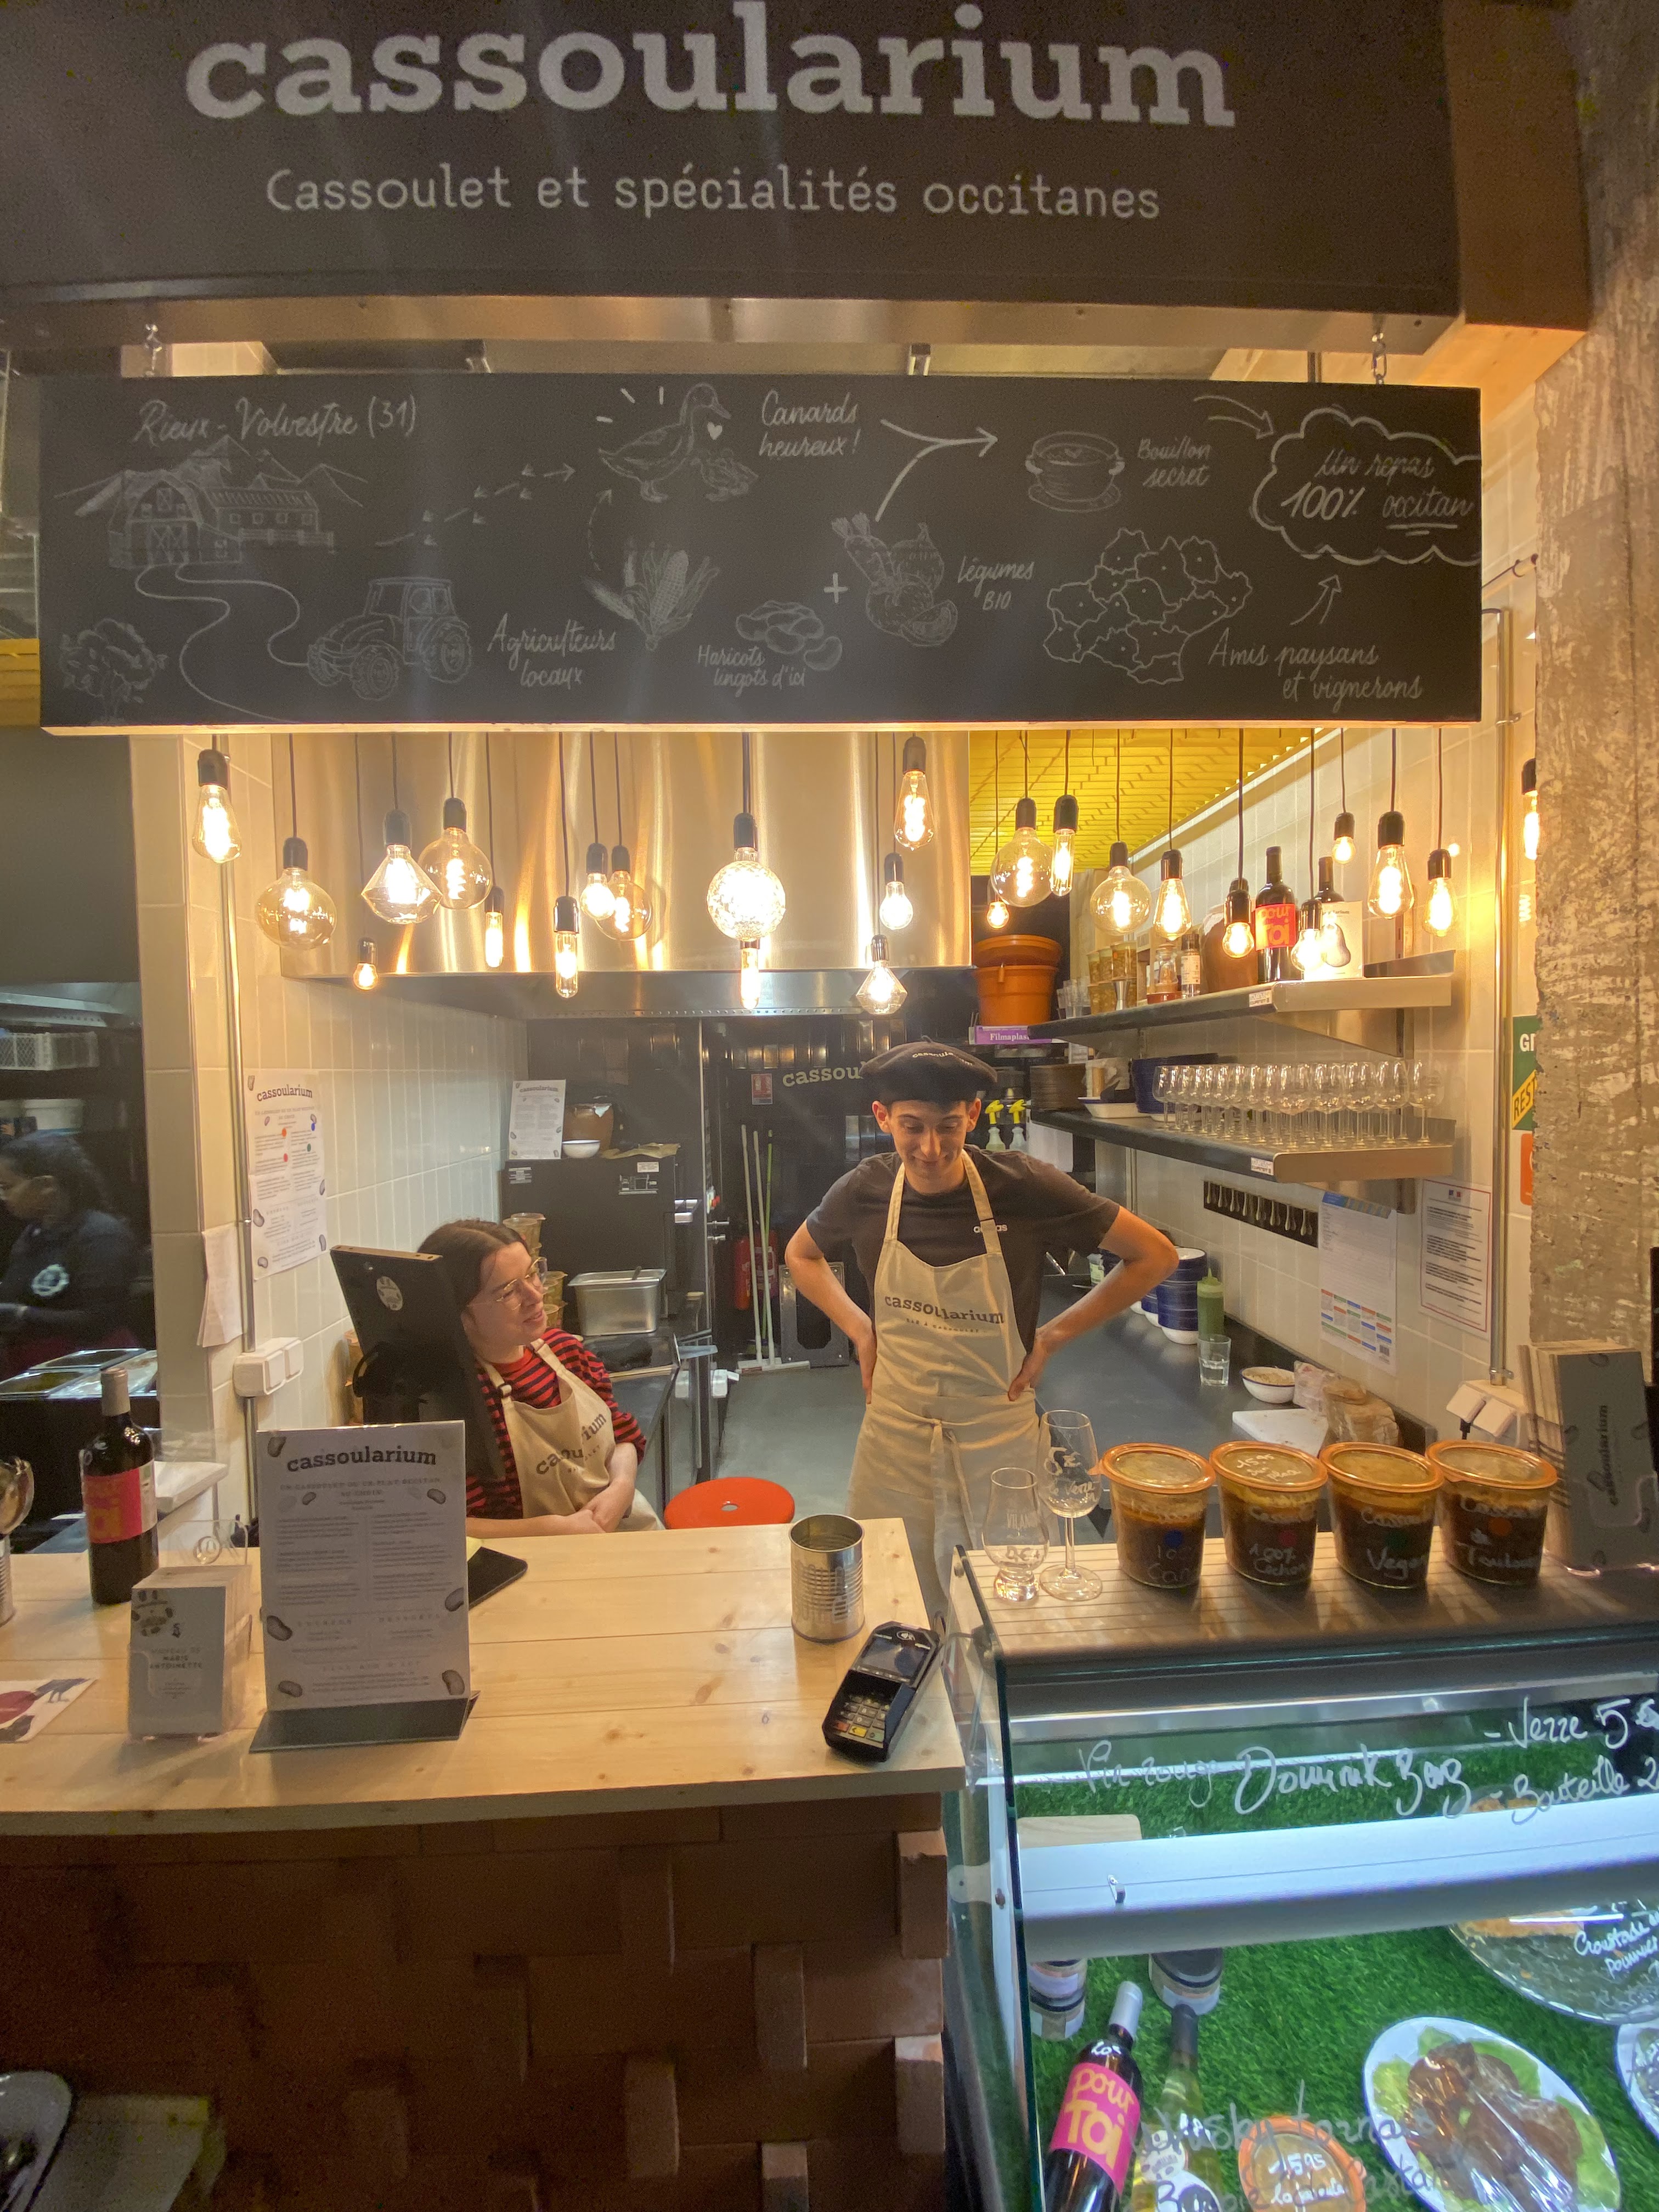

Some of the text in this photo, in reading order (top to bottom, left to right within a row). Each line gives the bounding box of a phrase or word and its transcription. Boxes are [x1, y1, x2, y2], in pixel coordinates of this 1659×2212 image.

[185, 1, 1235, 127] cassoularium
[267, 163, 1160, 218] Cassoulet et spécialités occitanes
[761, 390, 859, 426] Canards
[1137, 437, 1211, 460] Bouillon
[1281, 482, 1475, 521] 100% occitan
[488, 612, 617, 670] Agriculteurs
[698, 645, 765, 667] Haricots
[1209, 628, 1380, 676] Amis paysans
[521, 659, 583, 689] locaux
[1283, 675, 1422, 713] et vignerons
[256, 1084, 313, 1102] cassoularium
[287, 1445, 437, 1472] cassoularium
